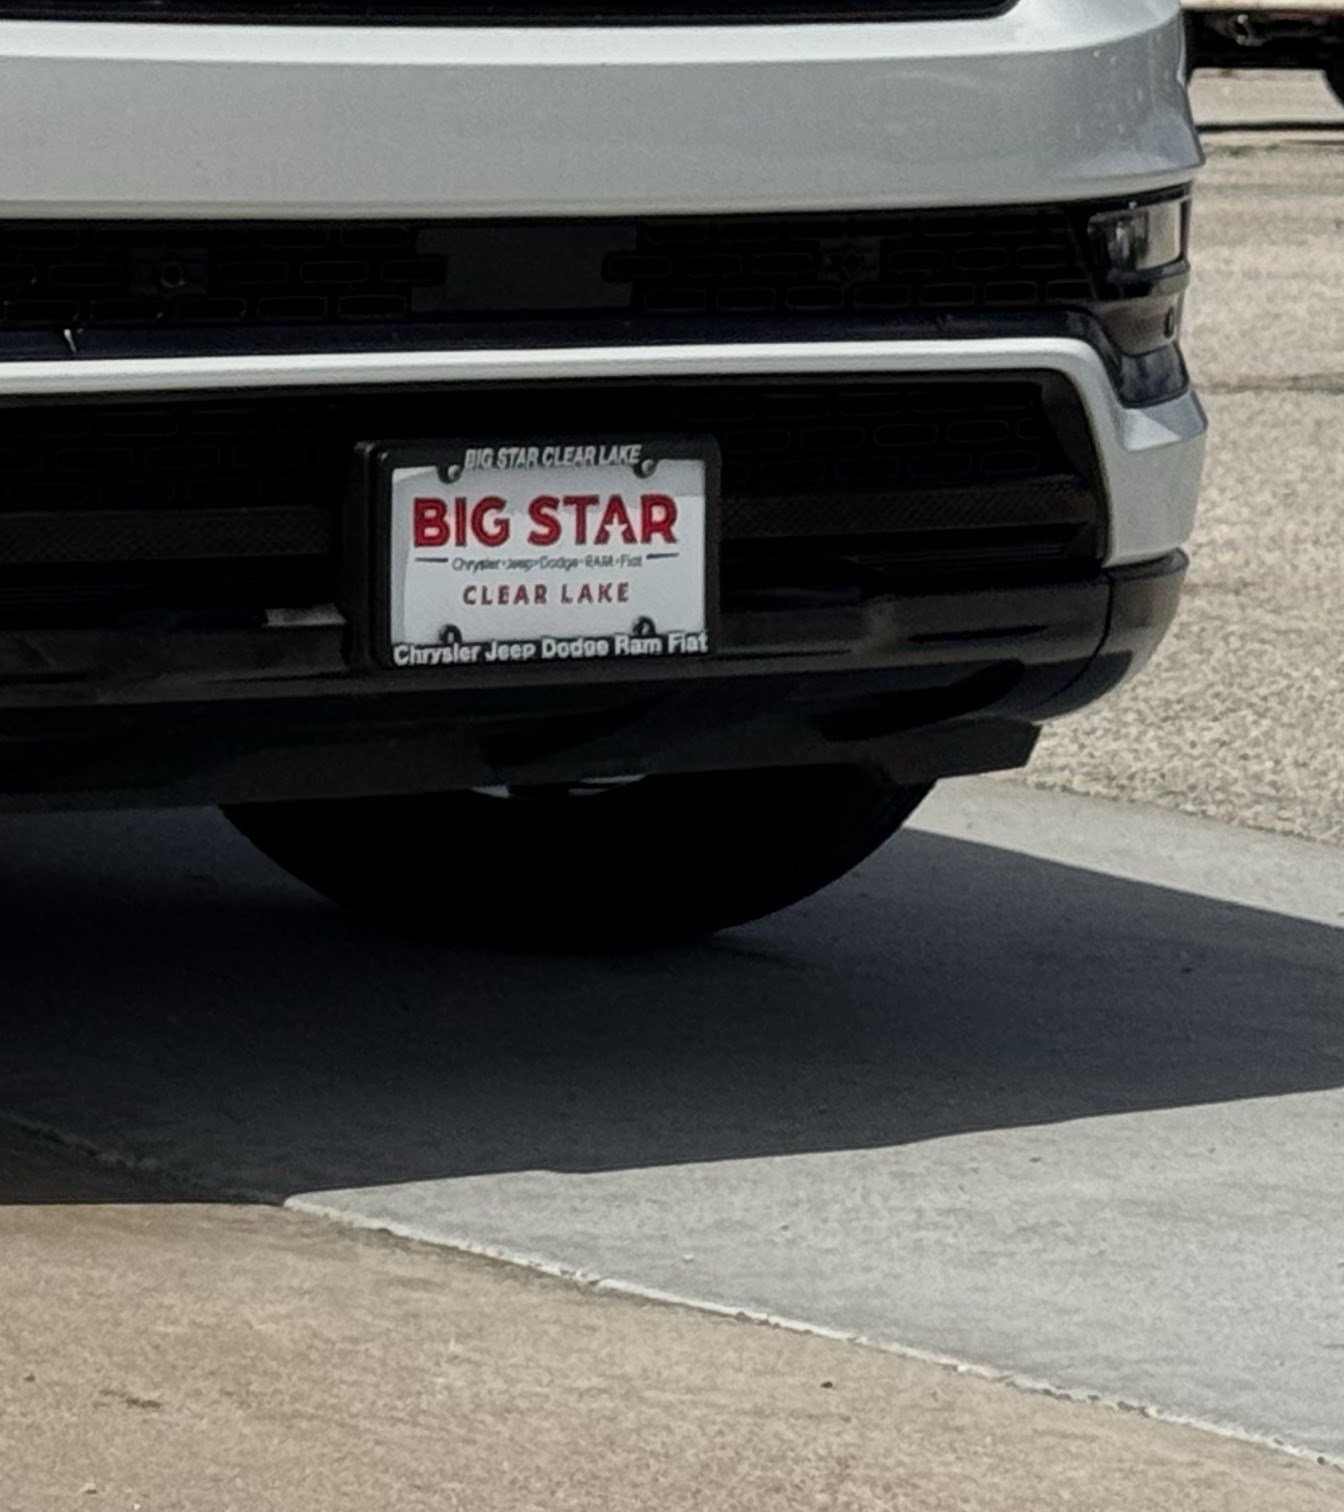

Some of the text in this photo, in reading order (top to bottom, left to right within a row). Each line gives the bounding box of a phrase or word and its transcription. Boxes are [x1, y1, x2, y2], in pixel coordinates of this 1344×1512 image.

[464, 443, 643, 469] BIG STAR CLEAR LAKE
[413, 493, 679, 549] BIG STAR
[462, 581, 631, 607] CLEAR LAKE
[392, 641, 480, 666] Chrysler
[485, 640, 537, 662] Jeep
[615, 634, 663, 656] Ram
[668, 631, 709, 654] Fiat
